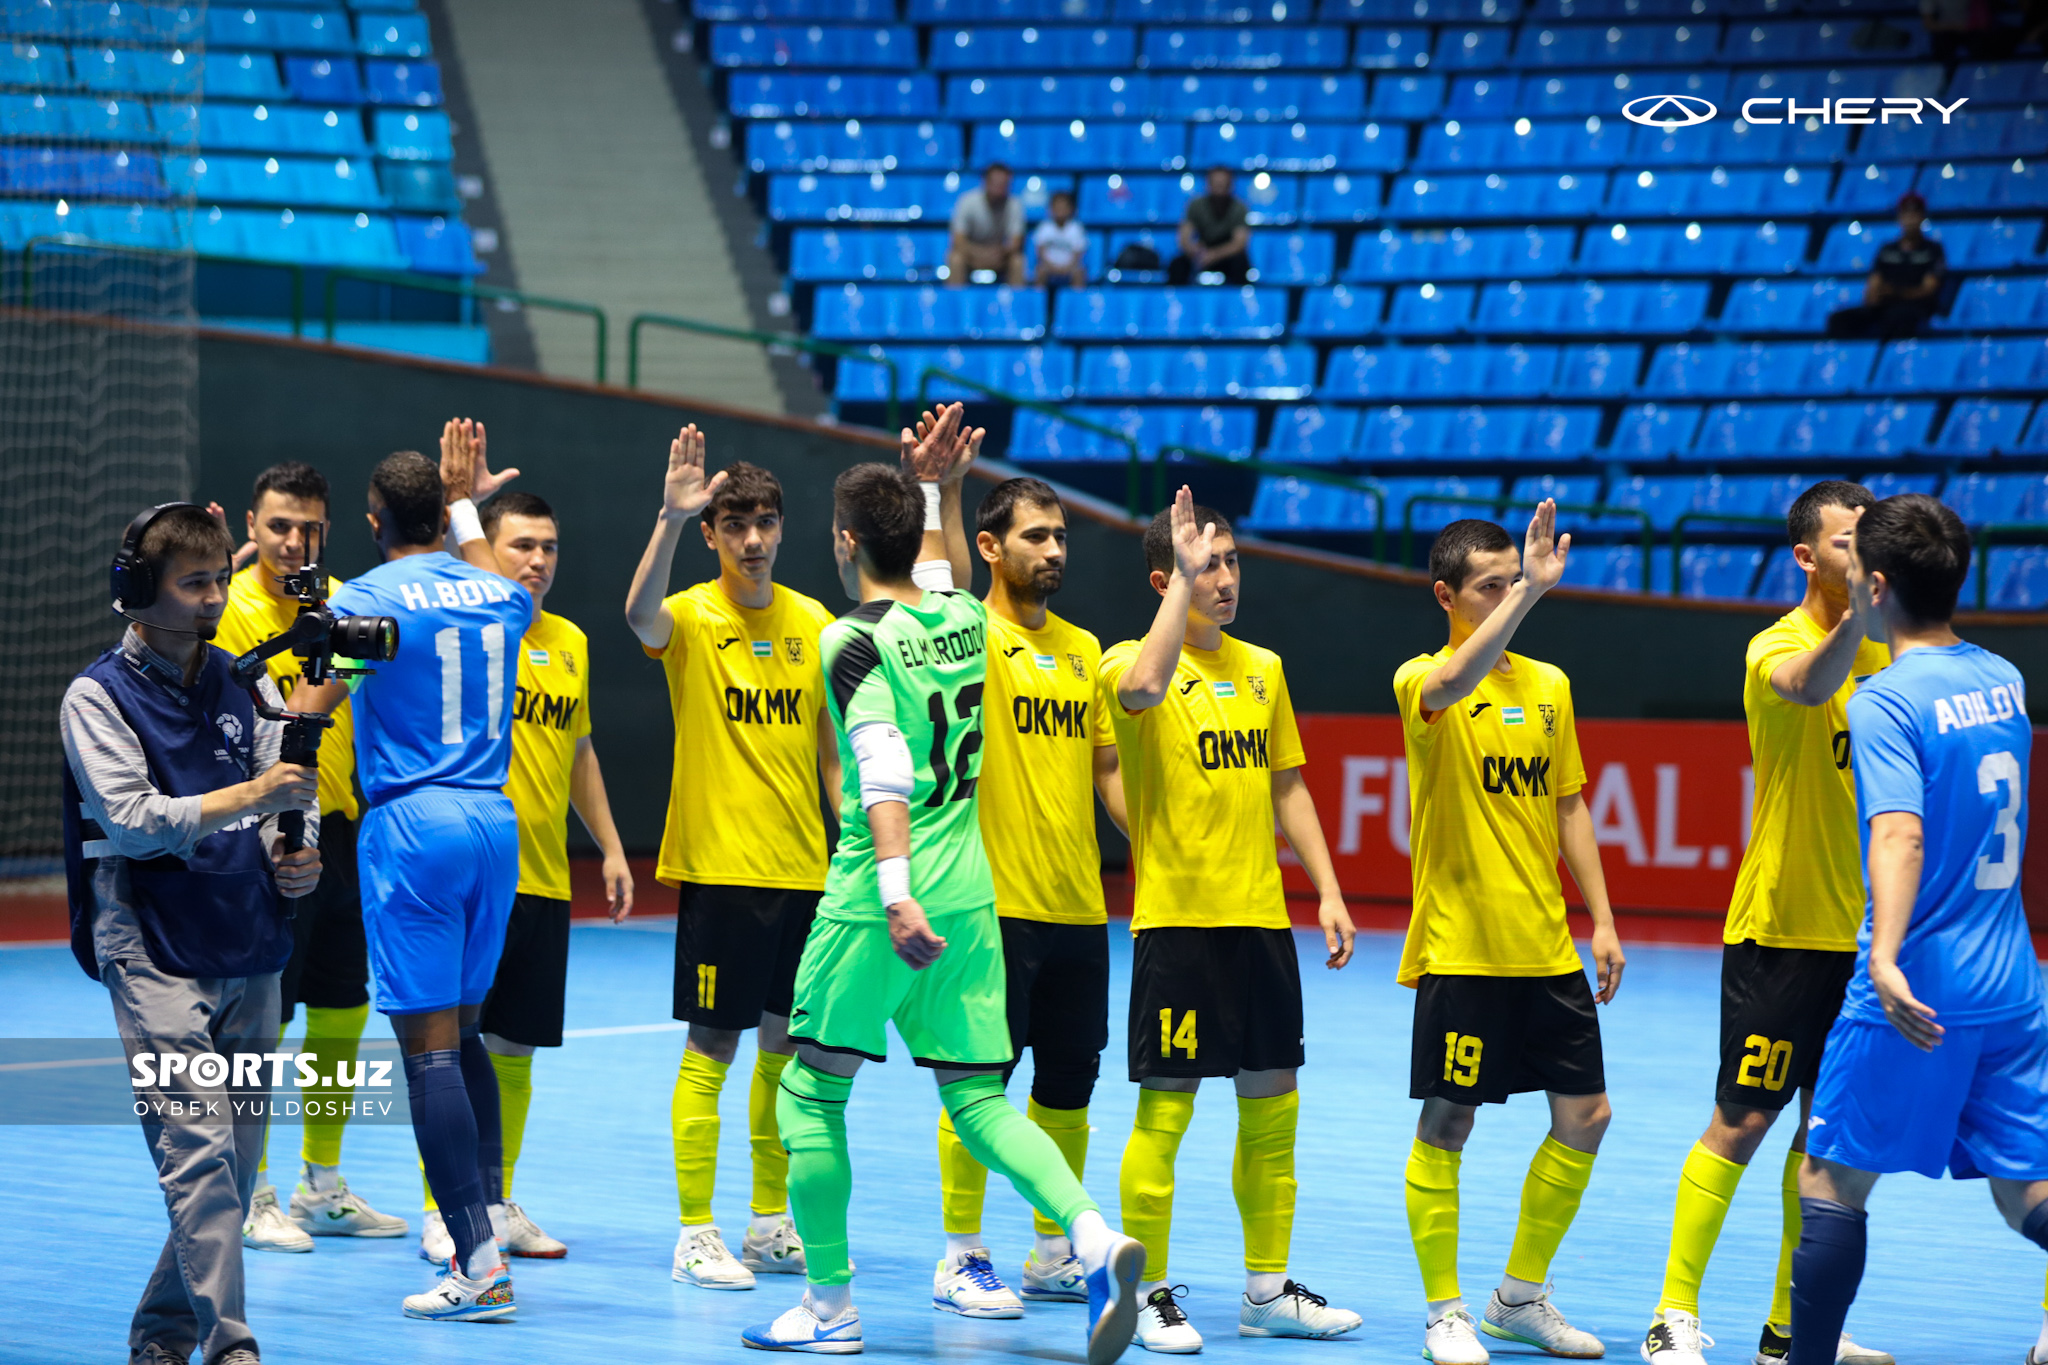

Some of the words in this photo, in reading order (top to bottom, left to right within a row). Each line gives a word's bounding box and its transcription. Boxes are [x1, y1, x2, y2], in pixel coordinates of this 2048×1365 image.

[236, 651, 260, 671] RONIN
[435, 622, 505, 745] 11
[512, 685, 579, 731] OKMK
[725, 686, 802, 725] OKMK
[1013, 695, 1088, 739] OKMK
[1934, 681, 2027, 735] ADILOV
[924, 681, 985, 808] 12
[1198, 728, 1269, 770] OKMK
[1483, 756, 1550, 797] OKMK
[1974, 750, 2021, 891] 3
[697, 963, 718, 1010] 11
[1159, 1007, 1198, 1060] 14
[1443, 1031, 1484, 1088] 19
[1736, 1033, 1794, 1092] 20
